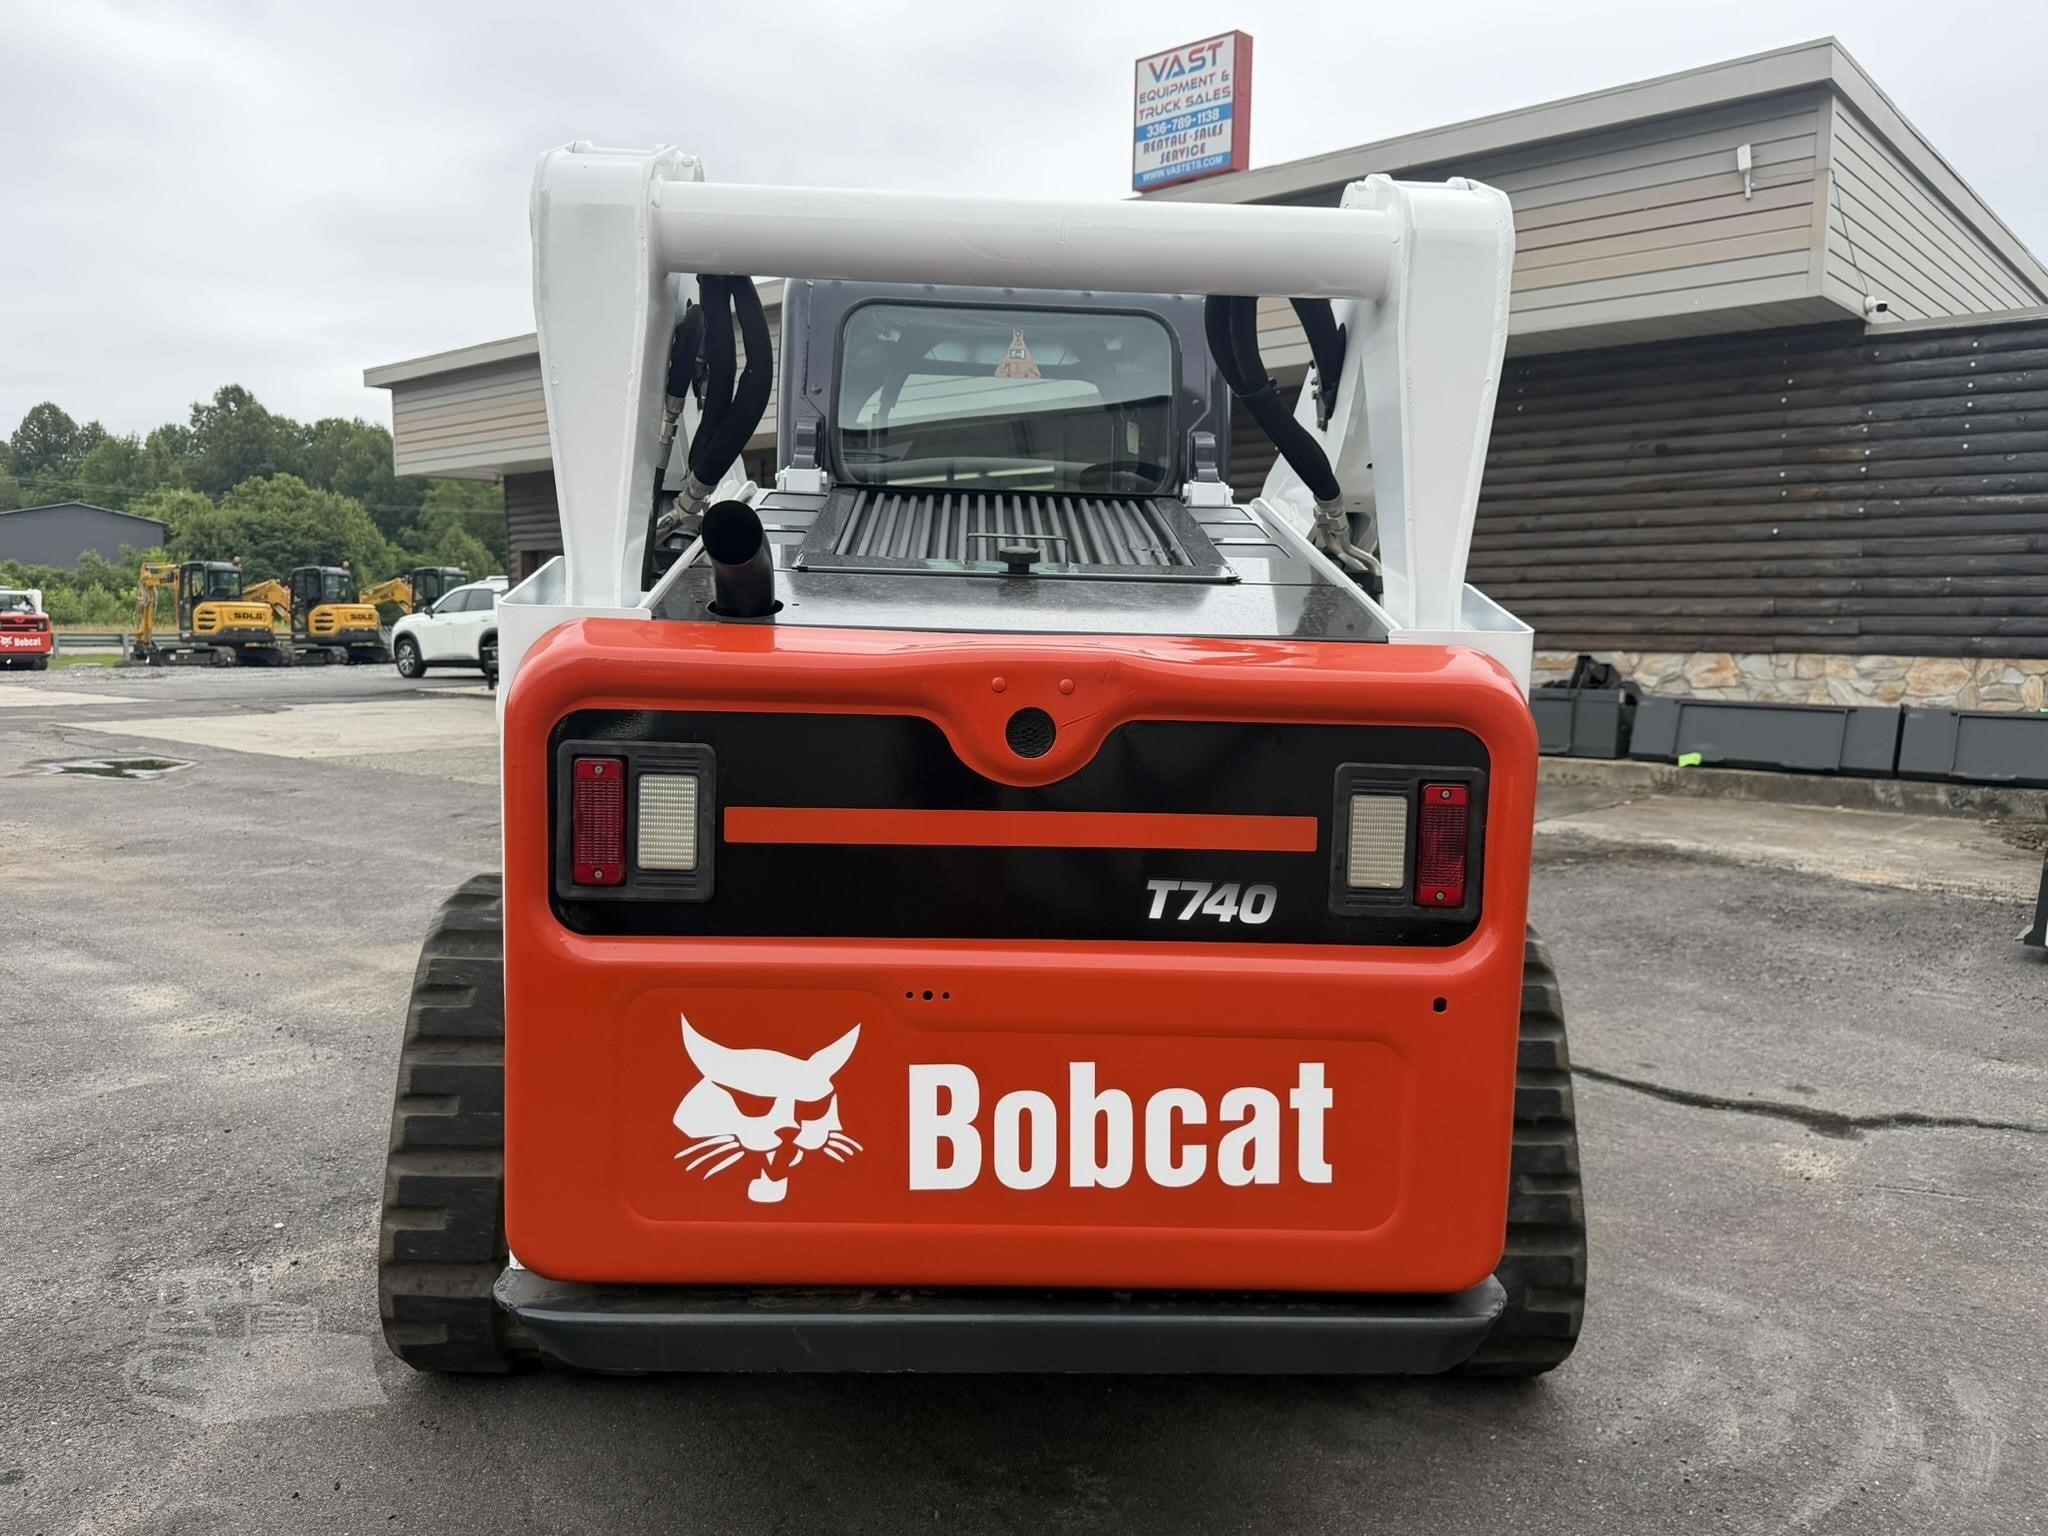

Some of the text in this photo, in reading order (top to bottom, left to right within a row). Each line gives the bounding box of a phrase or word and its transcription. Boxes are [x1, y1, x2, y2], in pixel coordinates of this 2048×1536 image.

[1148, 41, 1224, 83] VAST
[1138, 86, 1231, 121] TRUCK SALES
[1139, 69, 1230, 105] EQUIPMENT &
[1146, 108, 1220, 138] 336-789-1138
[1160, 142, 1206, 165] SERVICE
[14, 636, 41, 647] Bobcat
[1147, 879, 1278, 924] T740
[909, 1061, 1333, 1190] Bobcat
